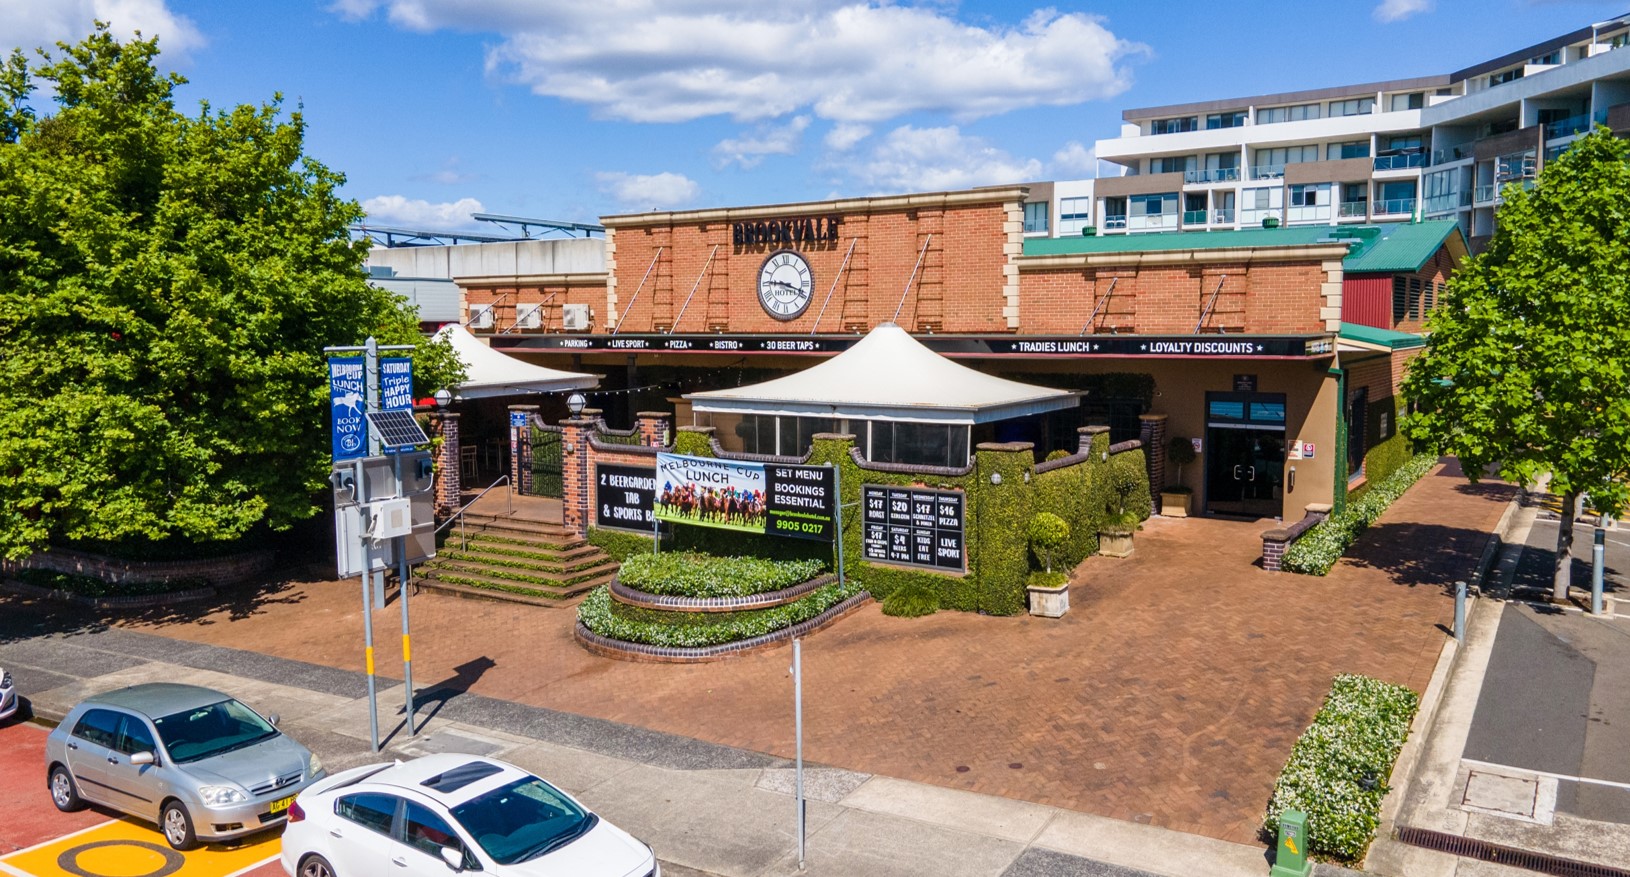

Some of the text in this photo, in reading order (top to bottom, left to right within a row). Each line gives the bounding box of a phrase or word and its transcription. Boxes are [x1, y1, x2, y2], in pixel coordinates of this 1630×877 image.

[733, 216, 838, 244] BROOKVALE
[564, 340, 588, 348] PARKING
[612, 340, 644, 348] LIVE SPORT
[669, 341, 688, 349] PIZZA
[714, 341, 738, 349] BISTRO
[766, 341, 814, 350] 30 BEER TAPS
[1019, 342, 1089, 352] TRADIES LUNCH
[1150, 342, 1253, 353] LOYALTY DISCOUNTS
[382, 362, 410, 374] SATURDAY
[346, 371, 363, 380] CUP
[333, 380, 363, 392] LUNCH
[384, 375, 410, 388] Triple
[384, 384, 410, 398] HAPPY
[385, 394, 412, 409] HOUR
[337, 416, 361, 425] BOOK
[336, 424, 361, 434] NOW
[660, 460, 760, 481] MELBOURNE CUP
[775, 468, 823, 481] SET MENU
[600, 473, 607, 486] 2
[686, 470, 729, 484] LUNCH
[774, 482, 825, 497] BOOKINGS
[624, 491, 640, 505] TAB
[774, 494, 825, 509] ESSENTIAL
[870, 500, 883, 509] $17
[893, 501, 908, 512] $20
[917, 504, 931, 514] $17
[603, 504, 611, 518] &
[613, 506, 642, 521] SPORTS
[940, 505, 955, 516] $16
[776, 519, 823, 534] 9905 0217
[940, 518, 958, 526] PIZZA
[917, 537, 931, 545] KIDS
[941, 538, 957, 549] LIVE
[919, 545, 929, 553] EAT
[938, 548, 960, 559] SPORT
[918, 553, 930, 561] FREE
